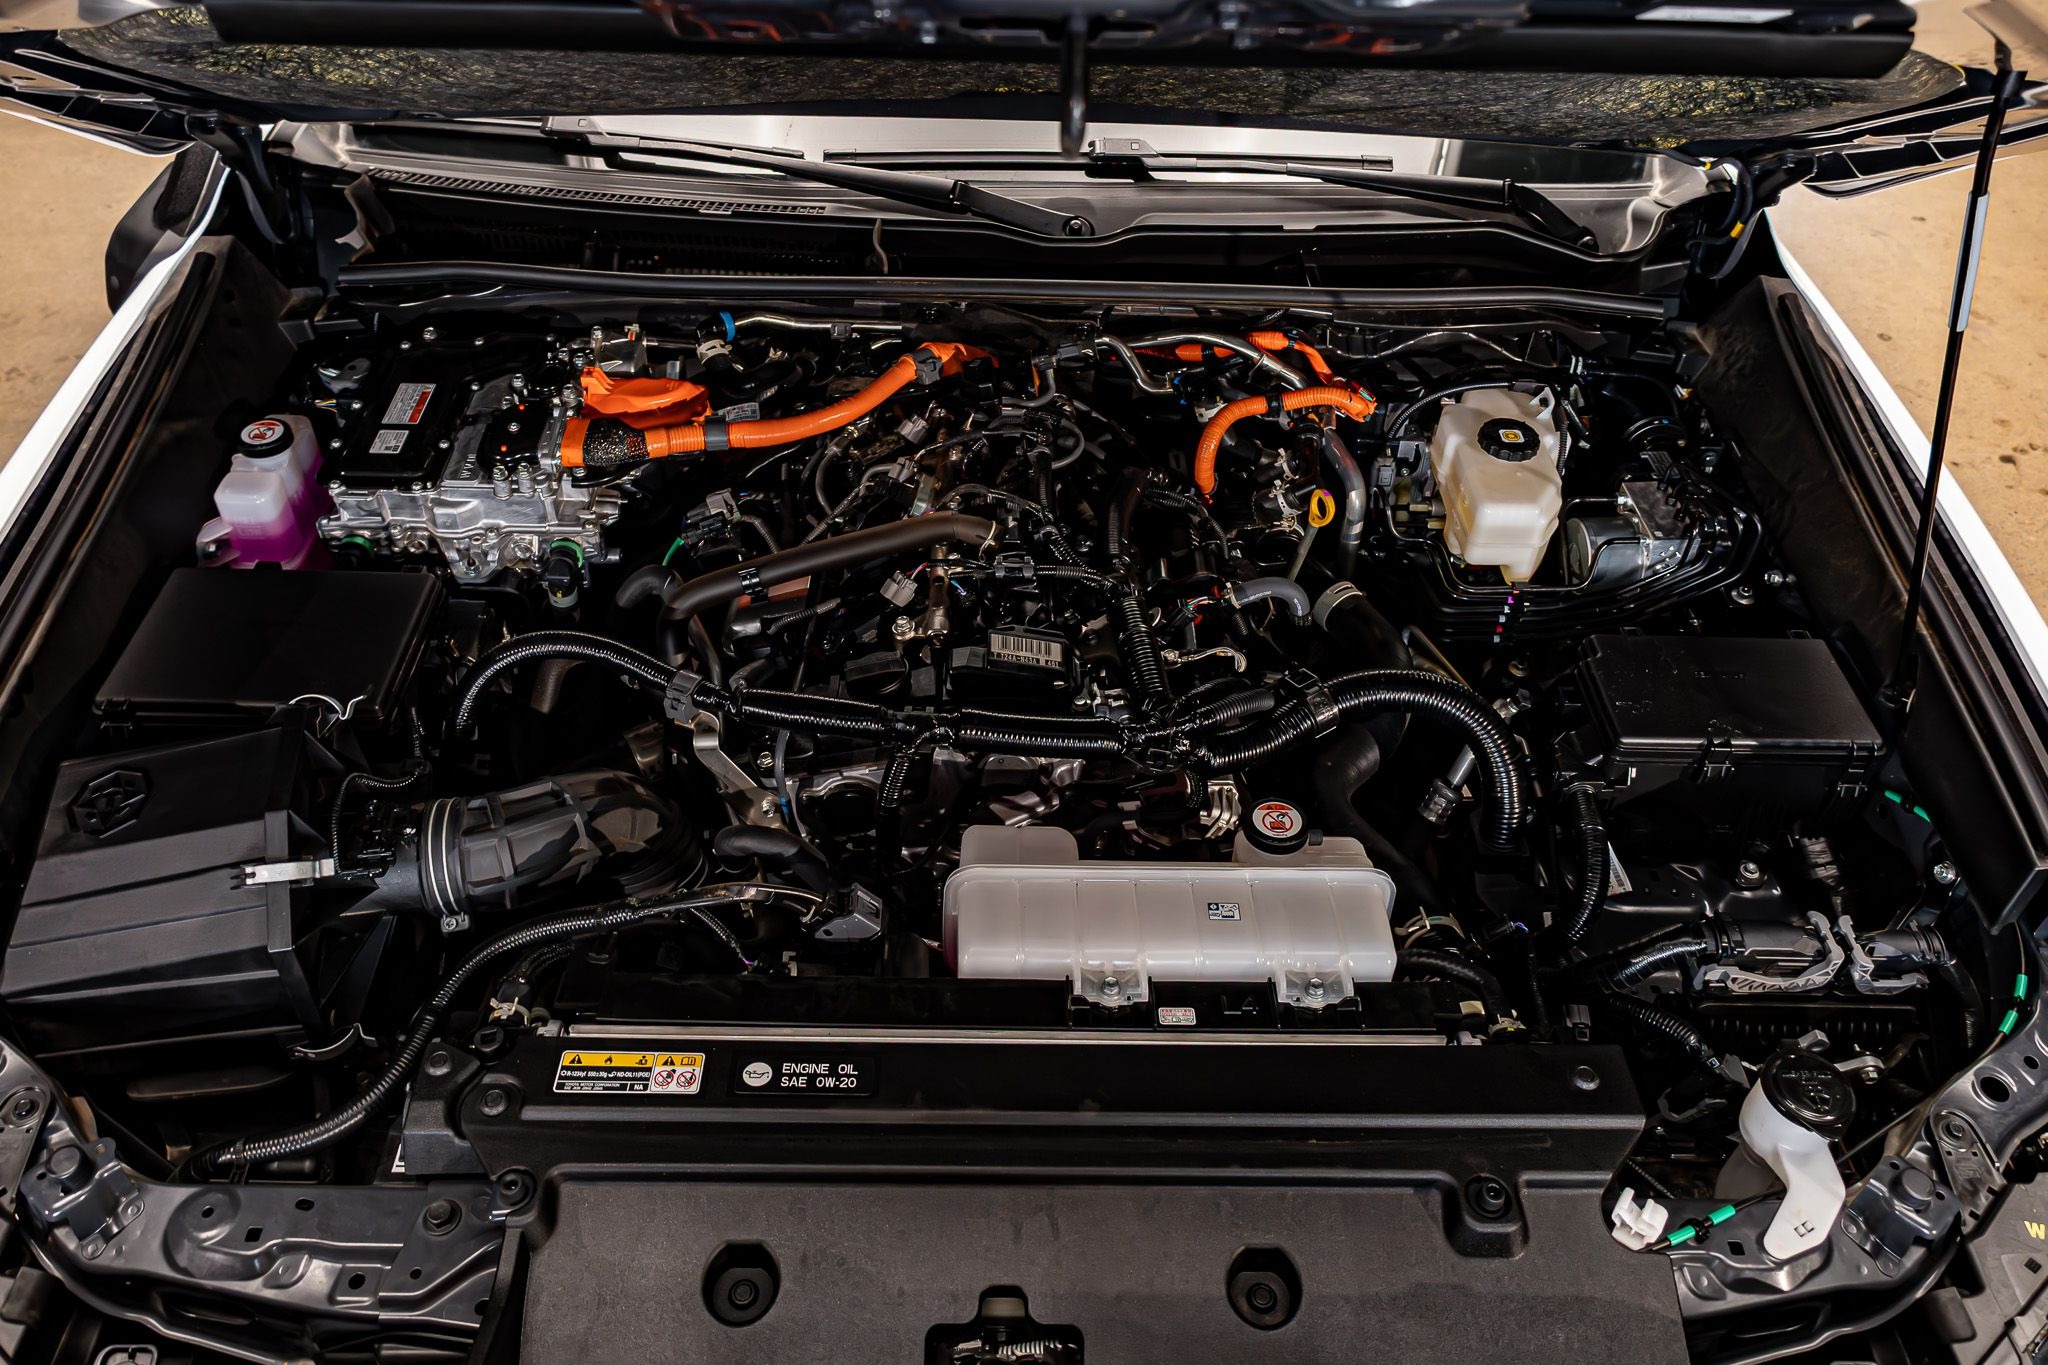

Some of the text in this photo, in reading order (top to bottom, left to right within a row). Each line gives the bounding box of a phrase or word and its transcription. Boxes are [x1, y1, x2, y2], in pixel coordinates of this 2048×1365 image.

[782, 1063, 859, 1075] ENGINE OIL
[780, 1076, 857, 1088] SAE 0W-20
[2023, 1220, 2046, 1240] W
